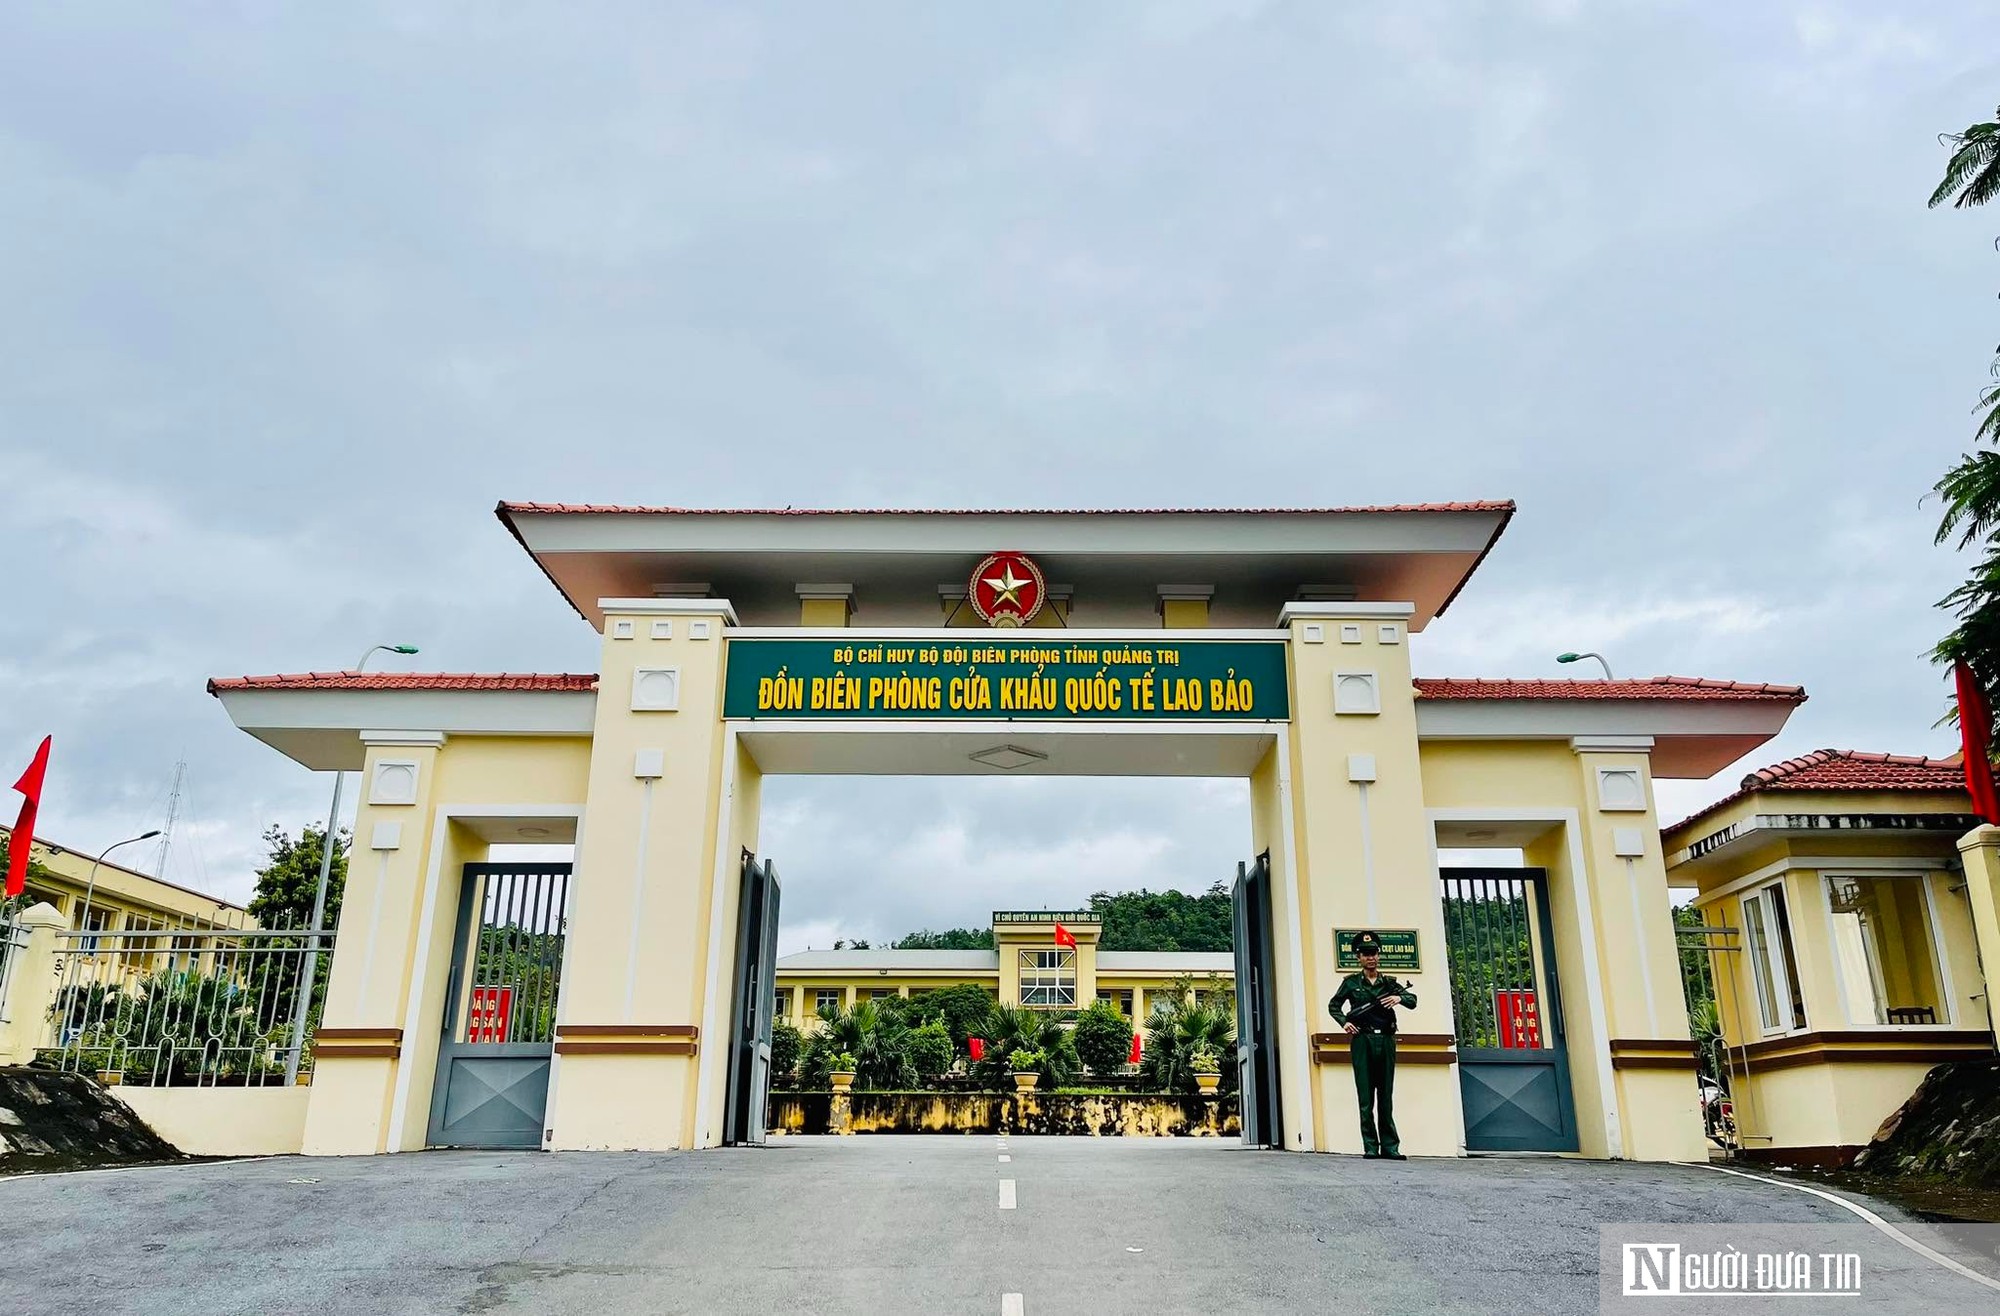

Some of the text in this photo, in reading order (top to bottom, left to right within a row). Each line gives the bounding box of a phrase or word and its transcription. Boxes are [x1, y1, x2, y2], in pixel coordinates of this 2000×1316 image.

[834, 644, 1179, 666] BỘ CHỈ HUY BỘ ĐỘI BIÊN PHÒNG TỈNH QUẢNG TRỊ
[758, 664, 1253, 714] ĐỒN BIÊN PHÒNG CỬA KHẨU QUỐC TẾ LAO BẢO
